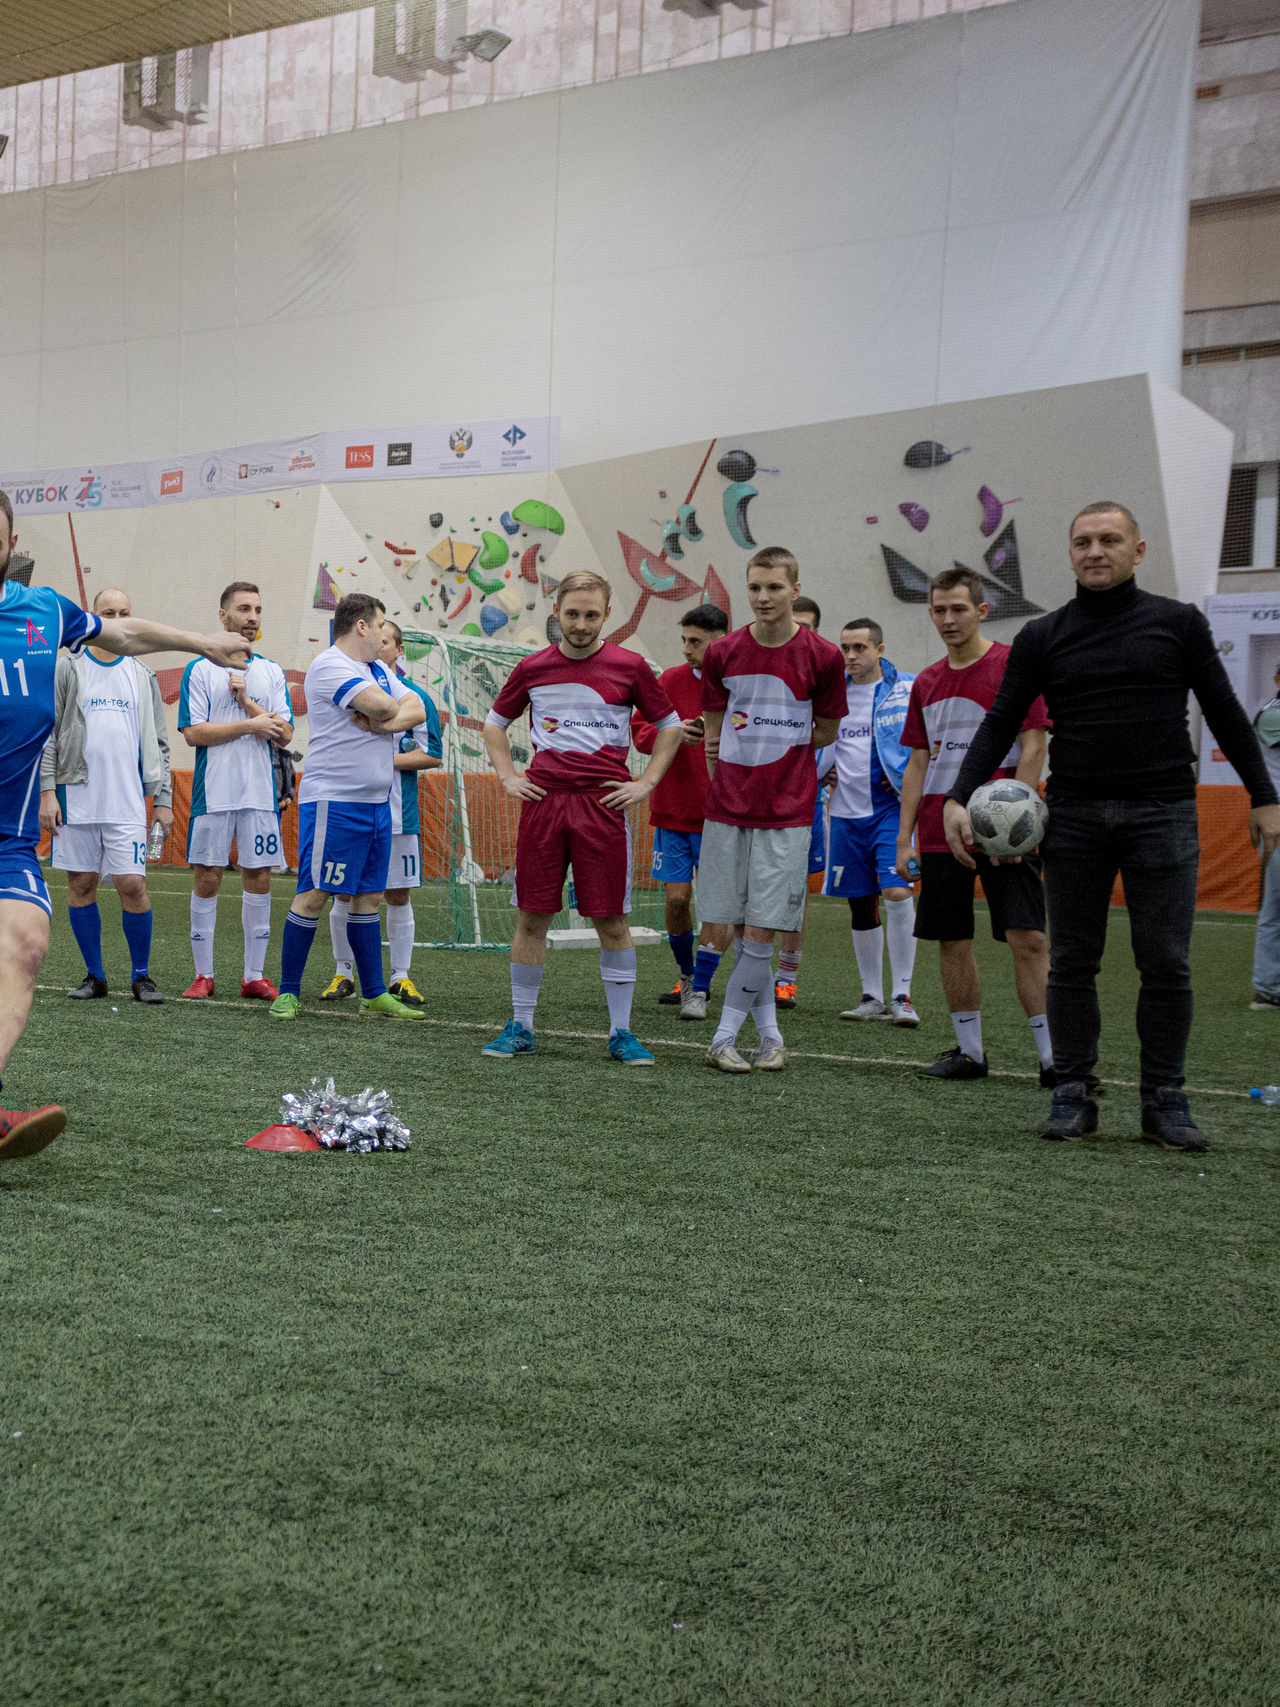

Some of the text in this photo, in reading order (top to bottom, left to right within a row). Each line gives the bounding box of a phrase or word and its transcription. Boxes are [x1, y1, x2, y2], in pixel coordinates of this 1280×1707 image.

[15, 485, 68, 504] КУБОК
[563, 719, 620, 730] Спецкабель
[132, 841, 146, 865] 13
[254, 834, 278, 856] 88
[401, 855, 417, 877] 11
[652, 850, 664, 870] 15
[323, 861, 347, 886] 15
[832, 865, 845, 888] 7
